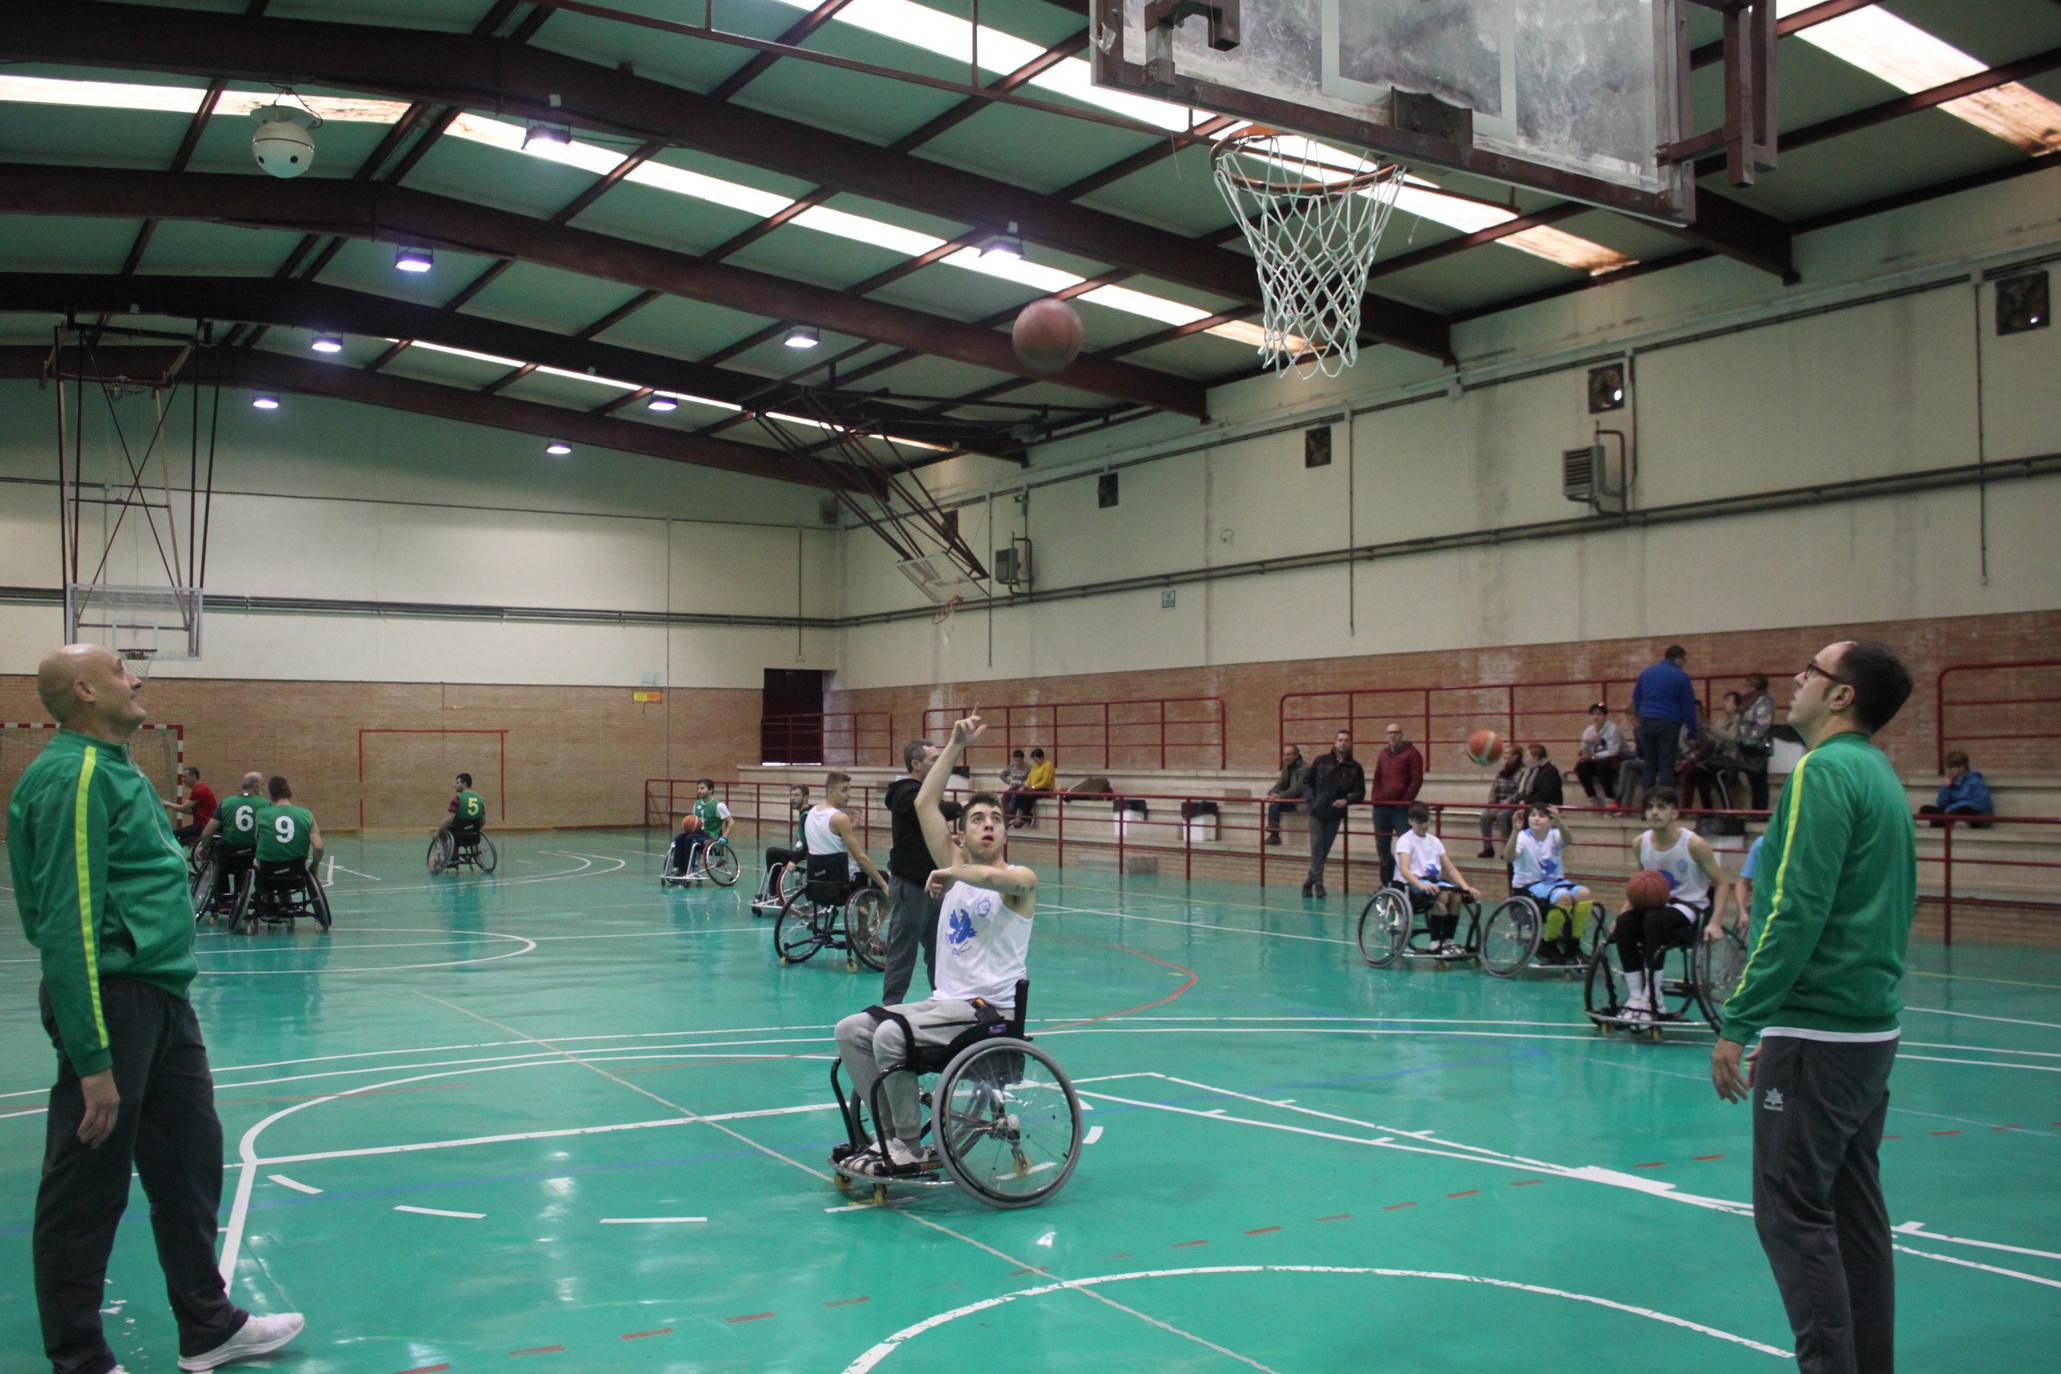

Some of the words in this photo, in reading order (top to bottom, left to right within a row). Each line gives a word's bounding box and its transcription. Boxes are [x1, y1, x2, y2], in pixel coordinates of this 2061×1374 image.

[235, 805, 254, 832] 6
[467, 797, 479, 816] 5
[275, 815, 295, 843] 9
